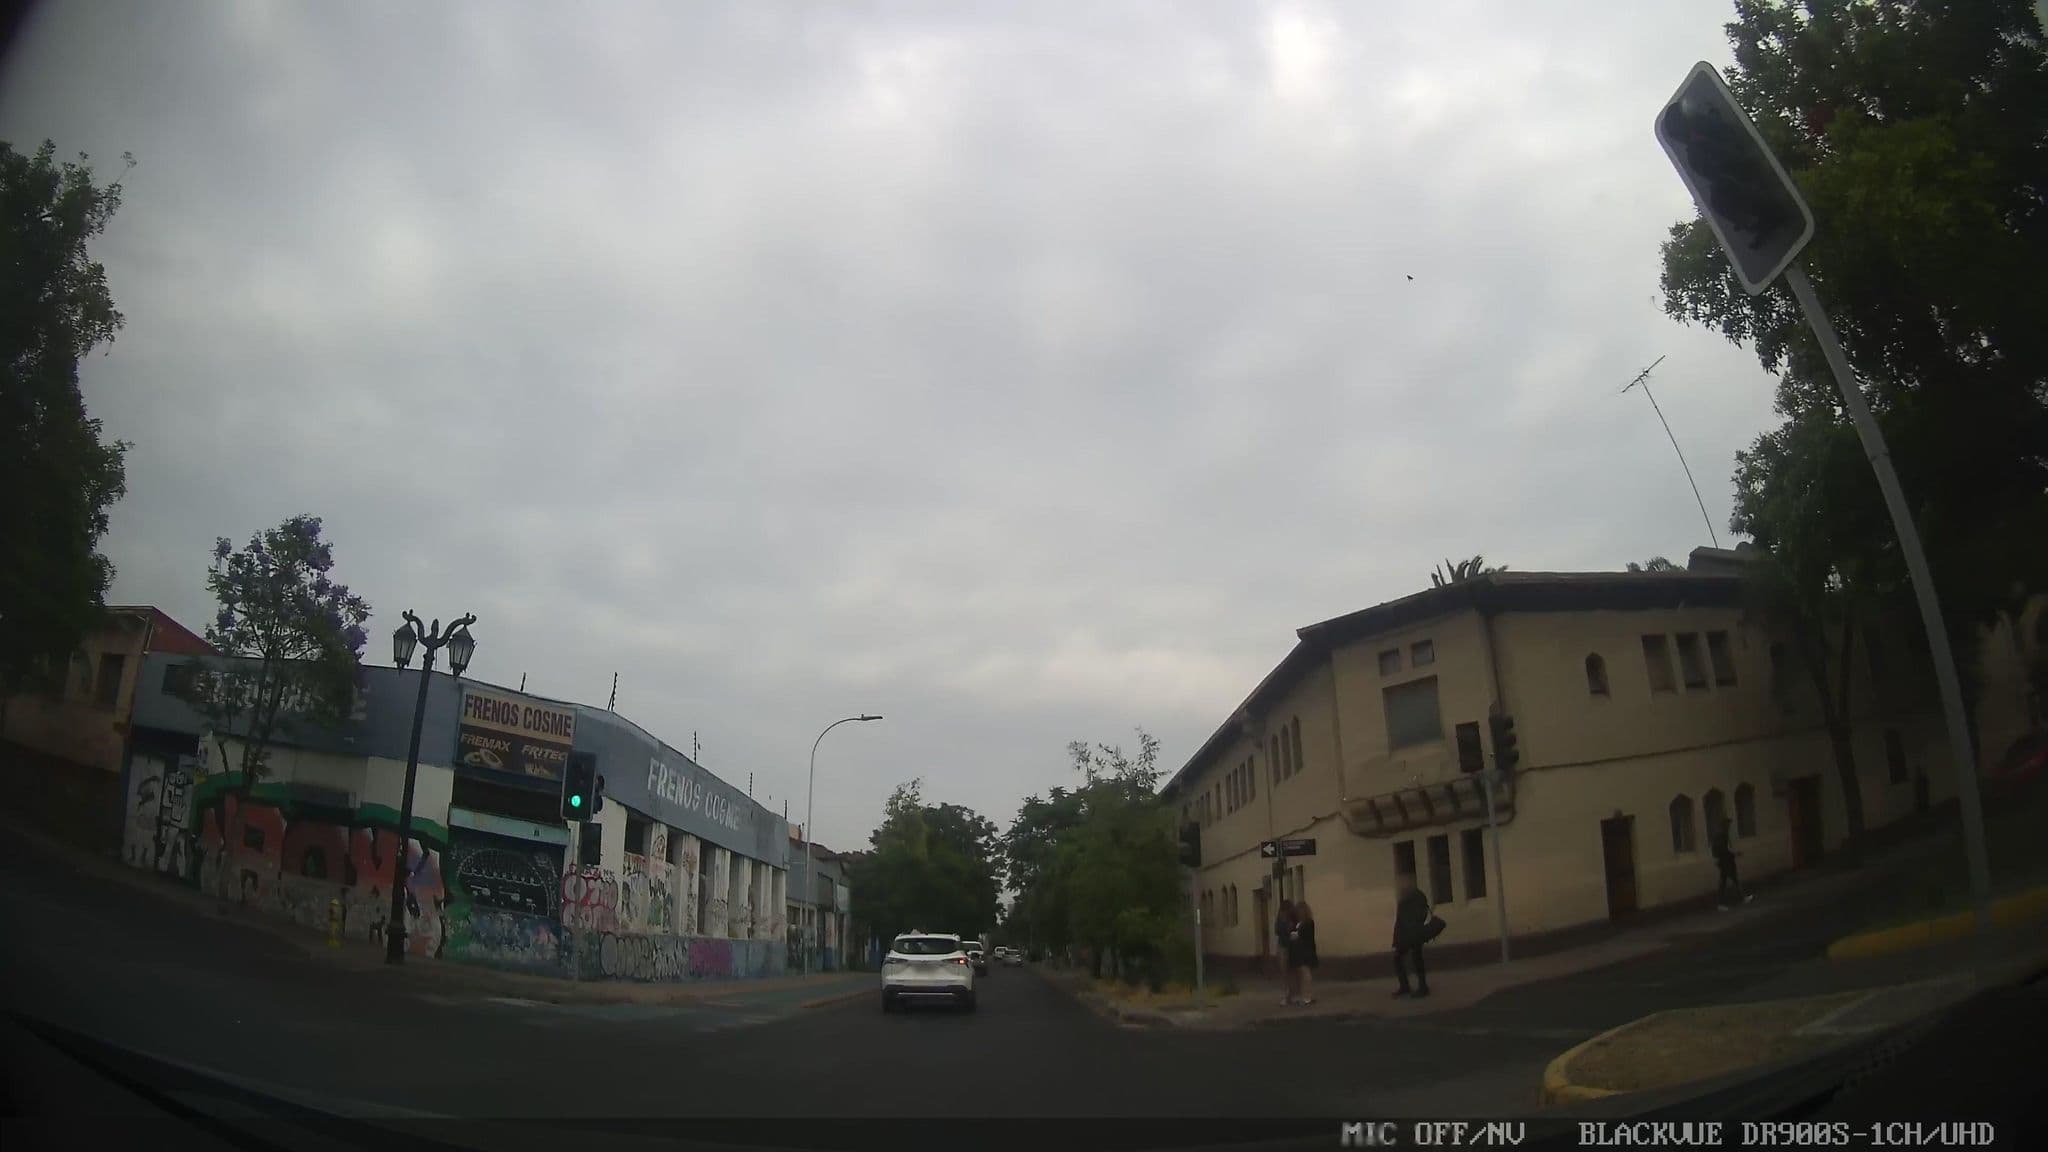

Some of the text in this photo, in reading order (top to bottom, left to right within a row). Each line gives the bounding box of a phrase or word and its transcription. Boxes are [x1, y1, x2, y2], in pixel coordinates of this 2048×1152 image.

[464, 694, 573, 738] FRENOS COSME
[459, 733, 513, 753] FREMAX
[647, 757, 702, 811] FRENOS
